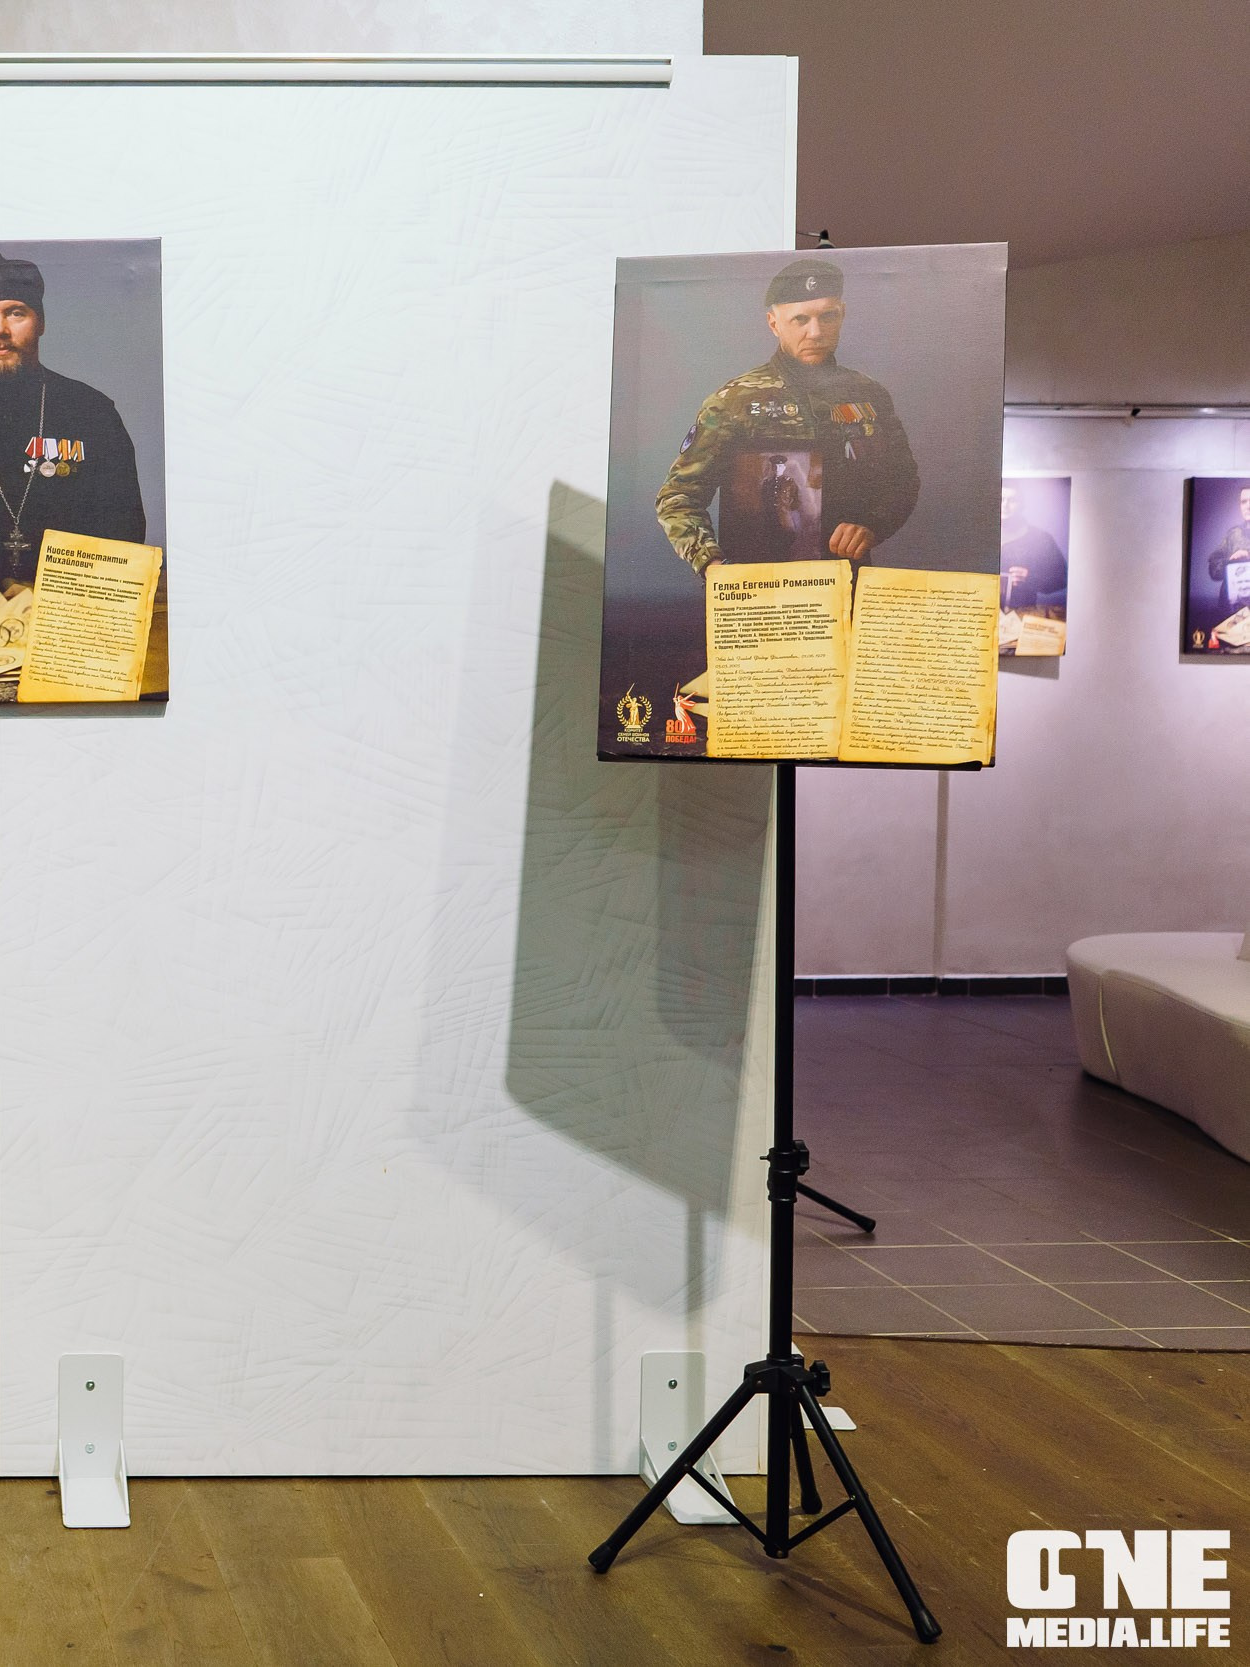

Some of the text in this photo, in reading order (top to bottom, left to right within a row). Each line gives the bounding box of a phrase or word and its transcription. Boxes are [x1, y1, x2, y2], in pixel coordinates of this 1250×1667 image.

[45, 554, 94, 569] Михайлович
[46, 545, 128, 565] Киосев Константин
[713, 578, 836, 591] Гелка Евгений Романович
[713, 592, 757, 601] «Сибирь»
[666, 720, 683, 733] 80
[666, 735, 697, 744] ПОБЕДА!
